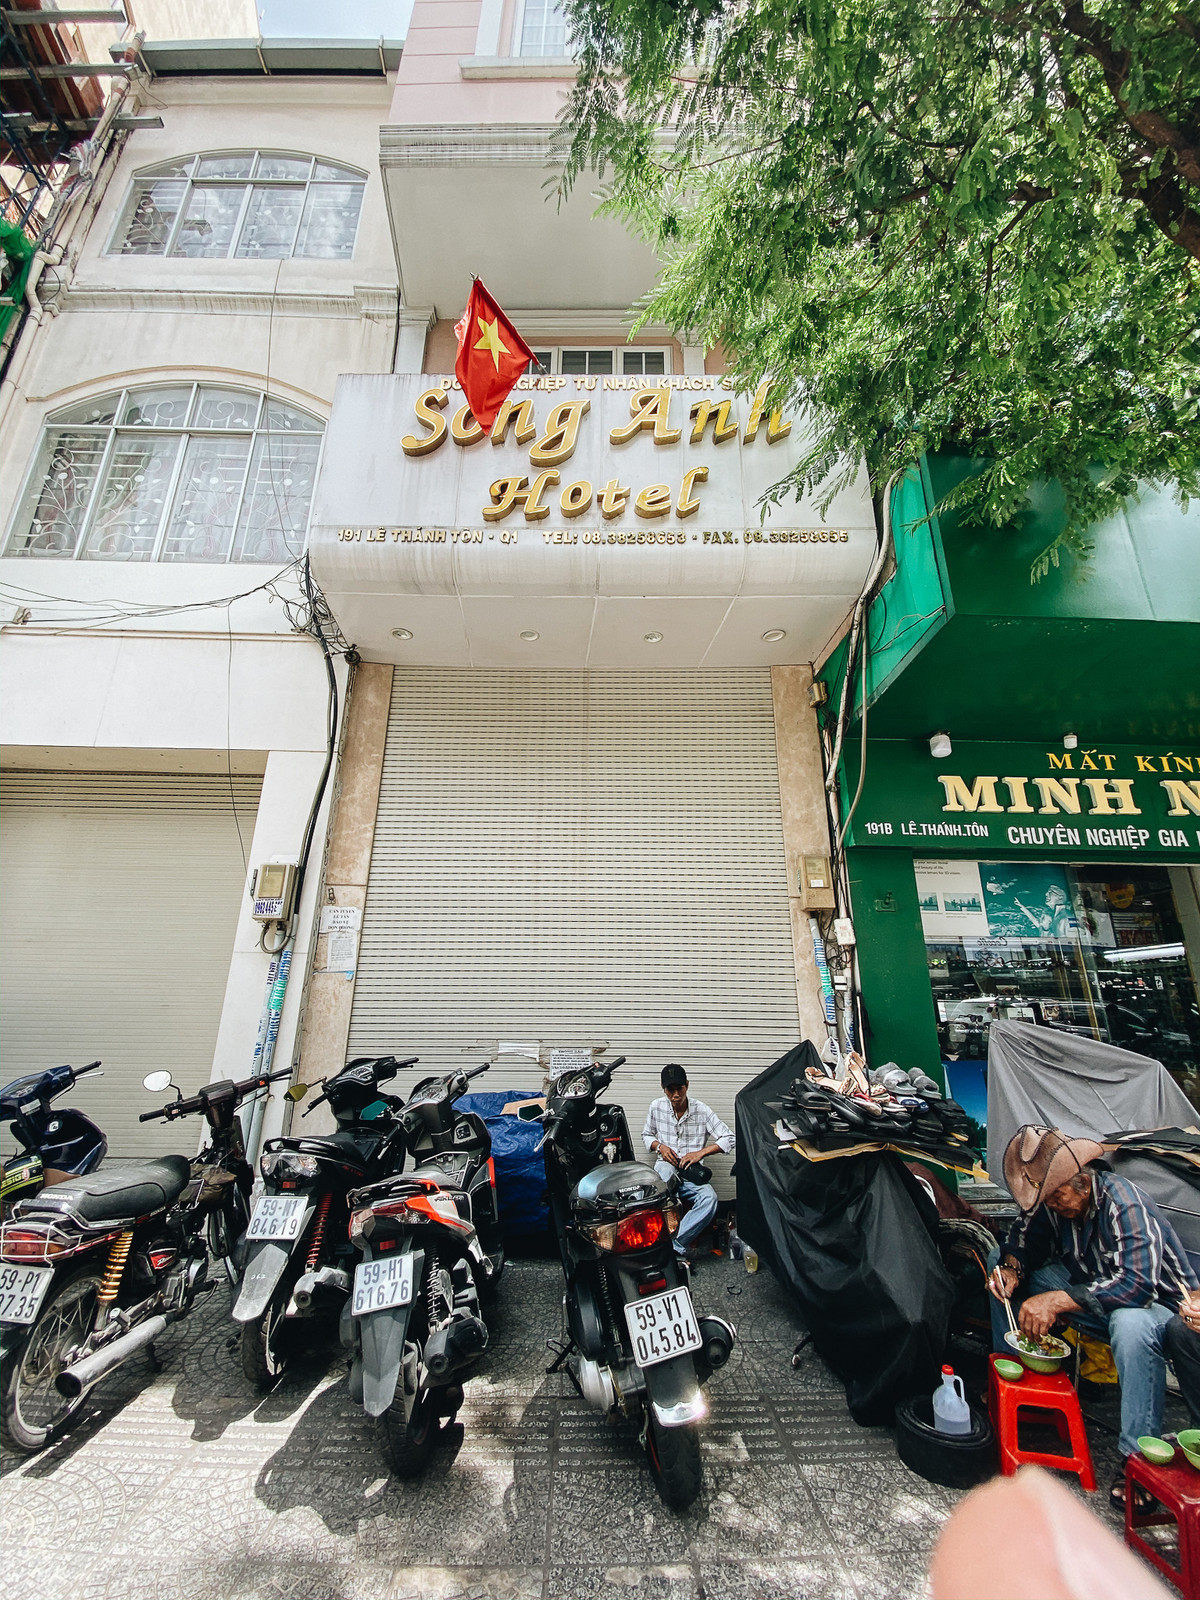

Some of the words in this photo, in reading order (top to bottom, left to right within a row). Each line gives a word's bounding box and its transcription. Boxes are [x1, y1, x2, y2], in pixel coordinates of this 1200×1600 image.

[512, 376, 566, 393] GHIỆP
[573, 376, 598, 391] TƯ
[603, 376, 651, 391] NHÂN
[656, 376, 715, 391] KHÁCH
[400, 388, 591, 467] Song
[609, 380, 794, 446] Anh
[482, 466, 709, 522] Hotel
[338, 529, 362, 542] 191
[366, 527, 386, 542] LÊ
[391, 527, 447, 543] THÁNH
[451, 528, 483, 543] TÔN
[500, 530, 519, 544] Q1
[543, 531, 578, 544] TEL:
[582, 531, 686, 544] 08.38258653
[702, 531, 739, 544] FAX.
[1046, 749, 1117, 771] MẮT
[937, 775, 1142, 815] MINH
[864, 822, 893, 835] 191B
[1007, 823, 1082, 846] CHUYÊN
[1087, 825, 1151, 849] NGHIỆP
[1157, 829, 1190, 847] GIA
[40, 1193, 74, 1201] HONDA
[251, 1218, 298, 1235] 846.19
[0, 1269, 41, 1293] 59-P1
[363, 1258, 403, 1286] 59-H1
[355, 1280, 409, 1311] 616.76
[635, 1294, 682, 1331] 59-V1
[636, 1319, 697, 1361] 045.84
